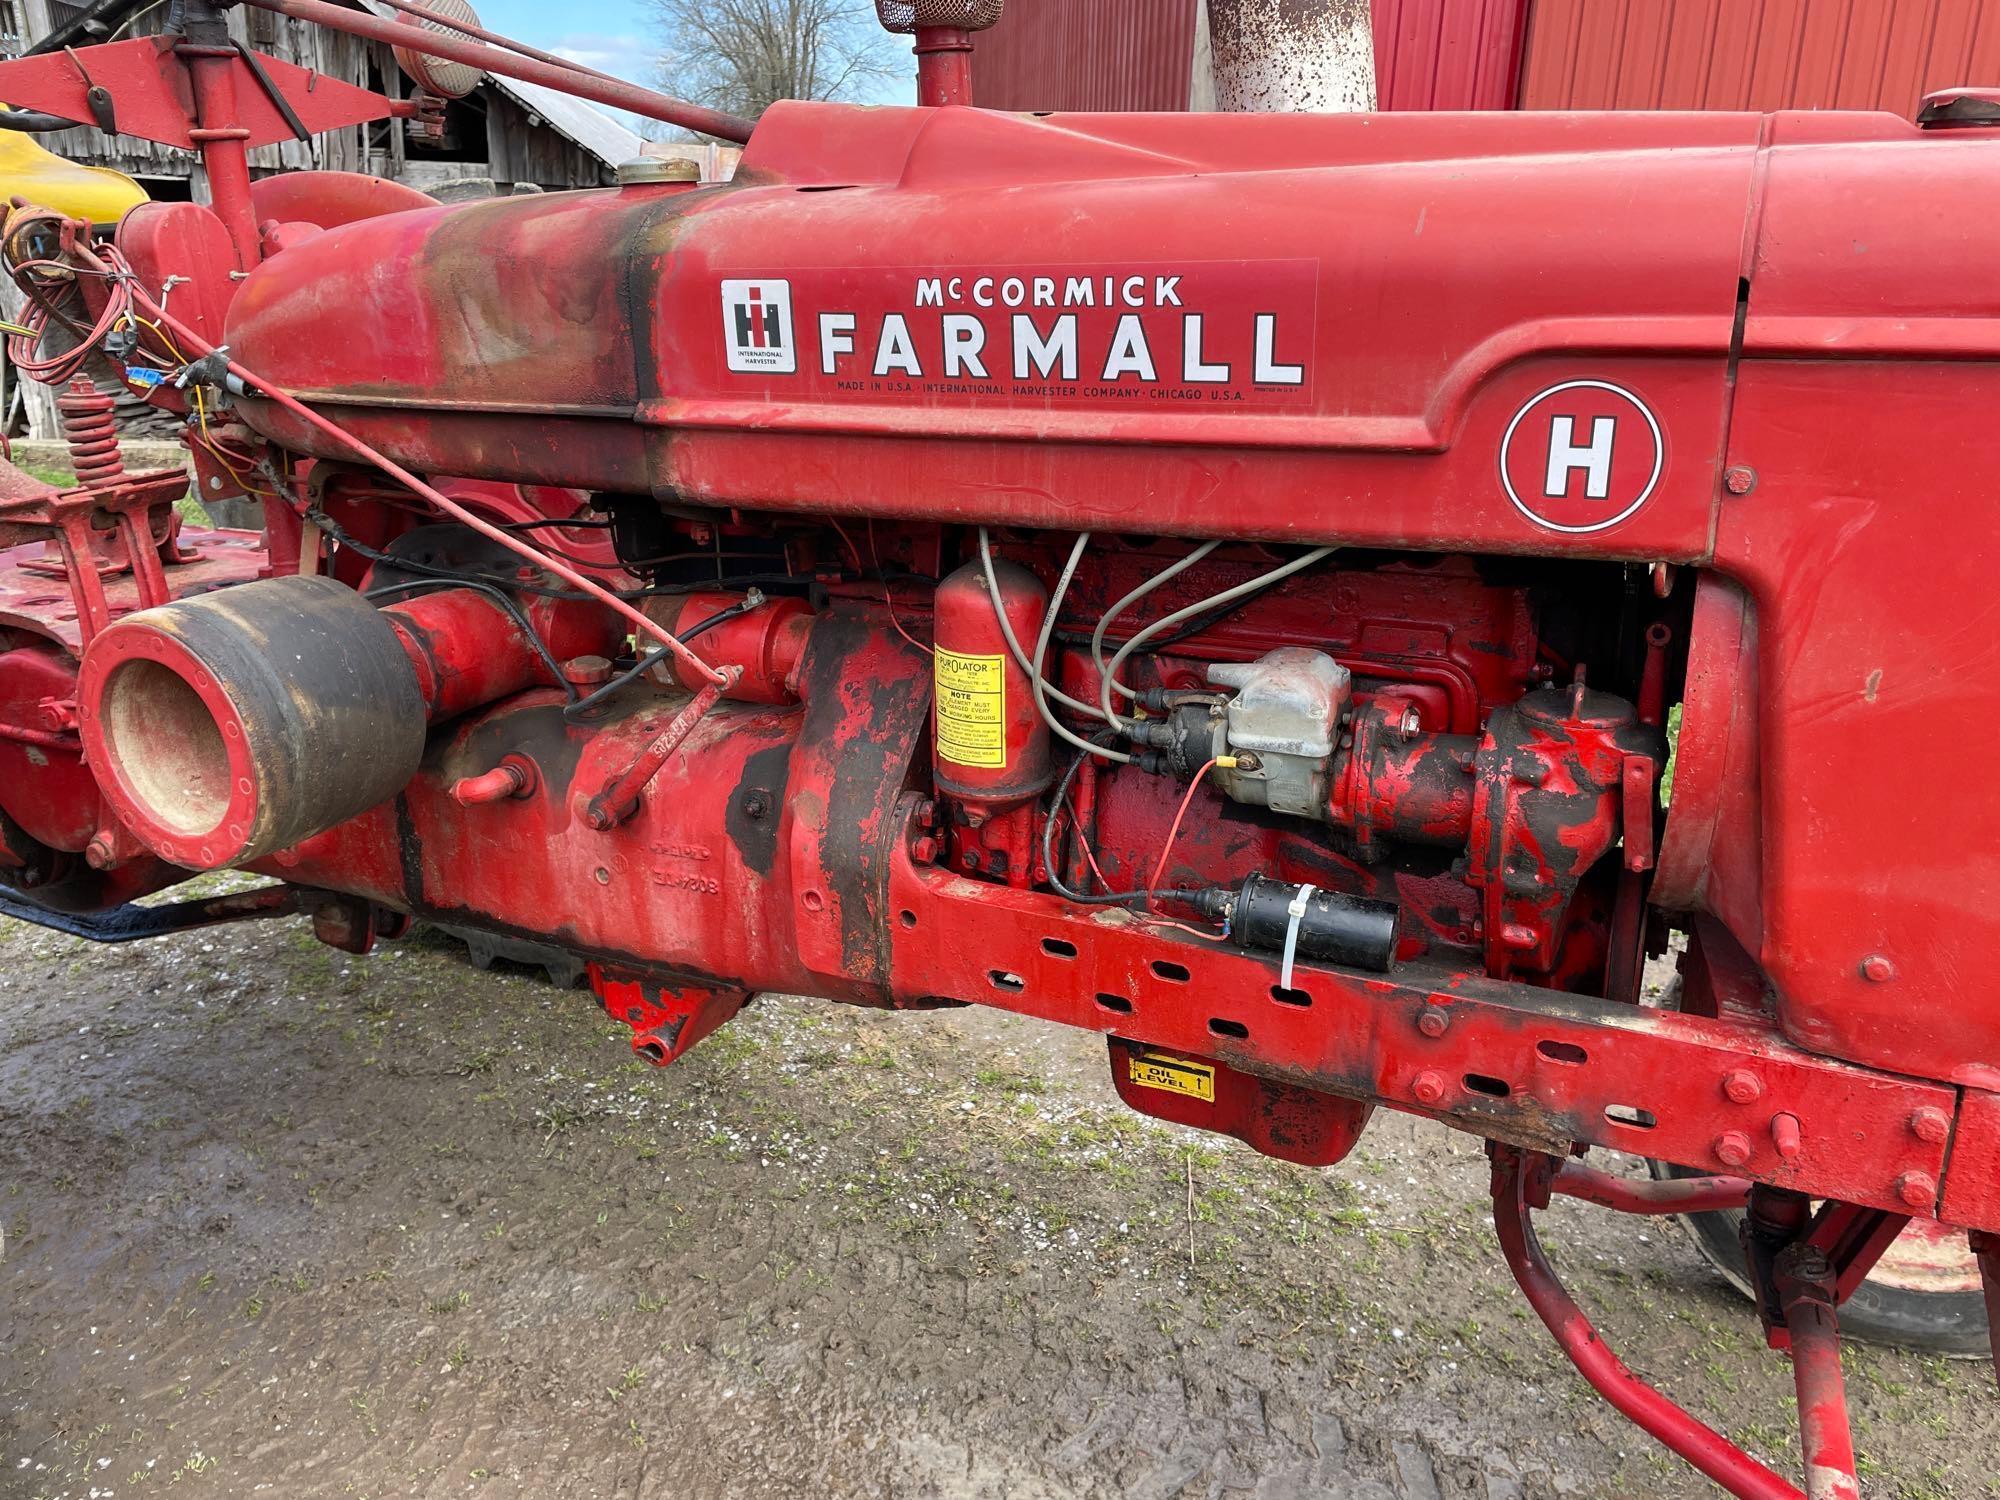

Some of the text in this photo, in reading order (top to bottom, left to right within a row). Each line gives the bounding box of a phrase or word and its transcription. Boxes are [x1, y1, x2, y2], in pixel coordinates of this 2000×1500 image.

[818, 312, 1305, 385] FARMALL
[837, 381, 865, 391] MADE
[870, 382, 881, 392] IN
[922, 383, 1006, 395] INTERNATIONAL
[1012, 386, 1077, 398] HARVESTER
[1083, 387, 1140, 398] COMPANY
[1150, 388, 1203, 400] CHICAGO
[1543, 414, 1618, 501] H
[939, 656, 988, 673] PUROLATOR
[951, 691, 971, 700] NOTE
[950, 711, 973, 720] WORKING
[1138, 1072, 1188, 1089] LEVEL
[1149, 1068, 1175, 1079] OIL
